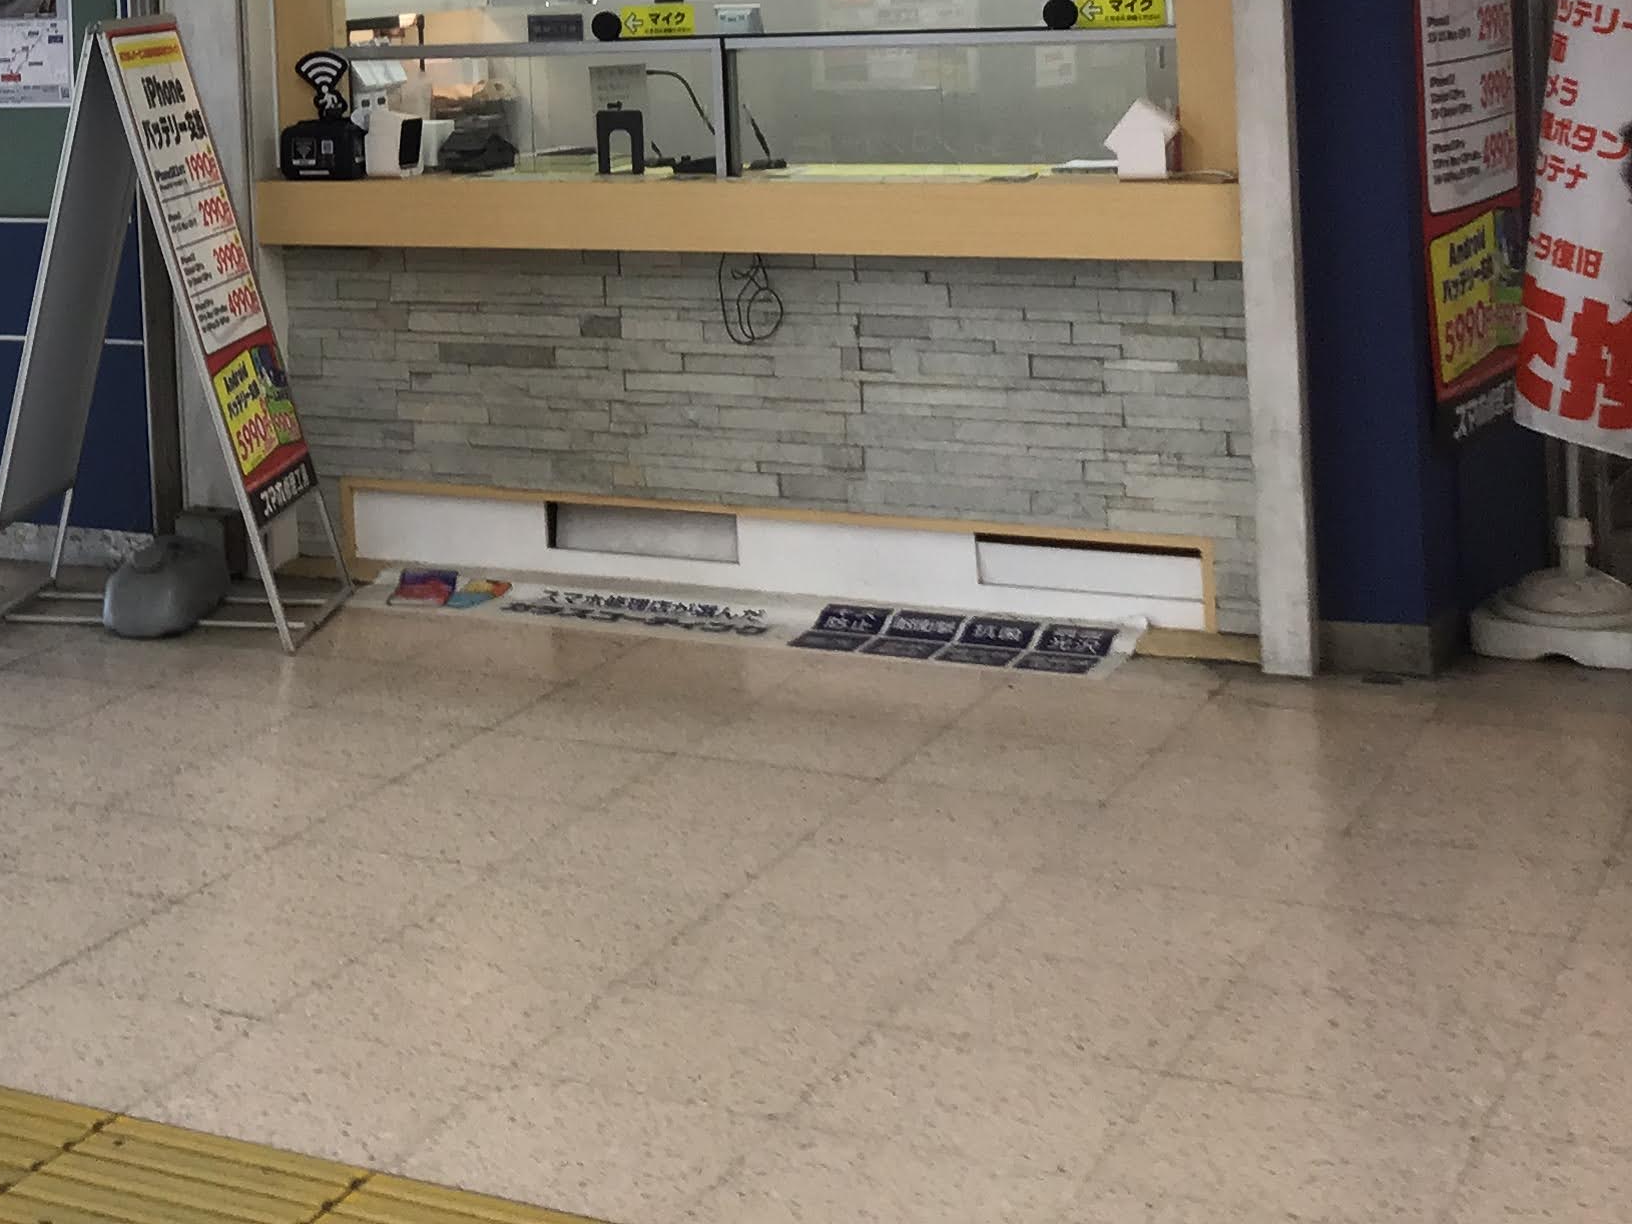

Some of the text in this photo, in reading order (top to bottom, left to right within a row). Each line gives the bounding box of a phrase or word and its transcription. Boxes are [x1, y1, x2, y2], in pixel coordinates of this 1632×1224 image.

[648, 12, 686, 26] マイク
[141, 75, 186, 110] iPhone
